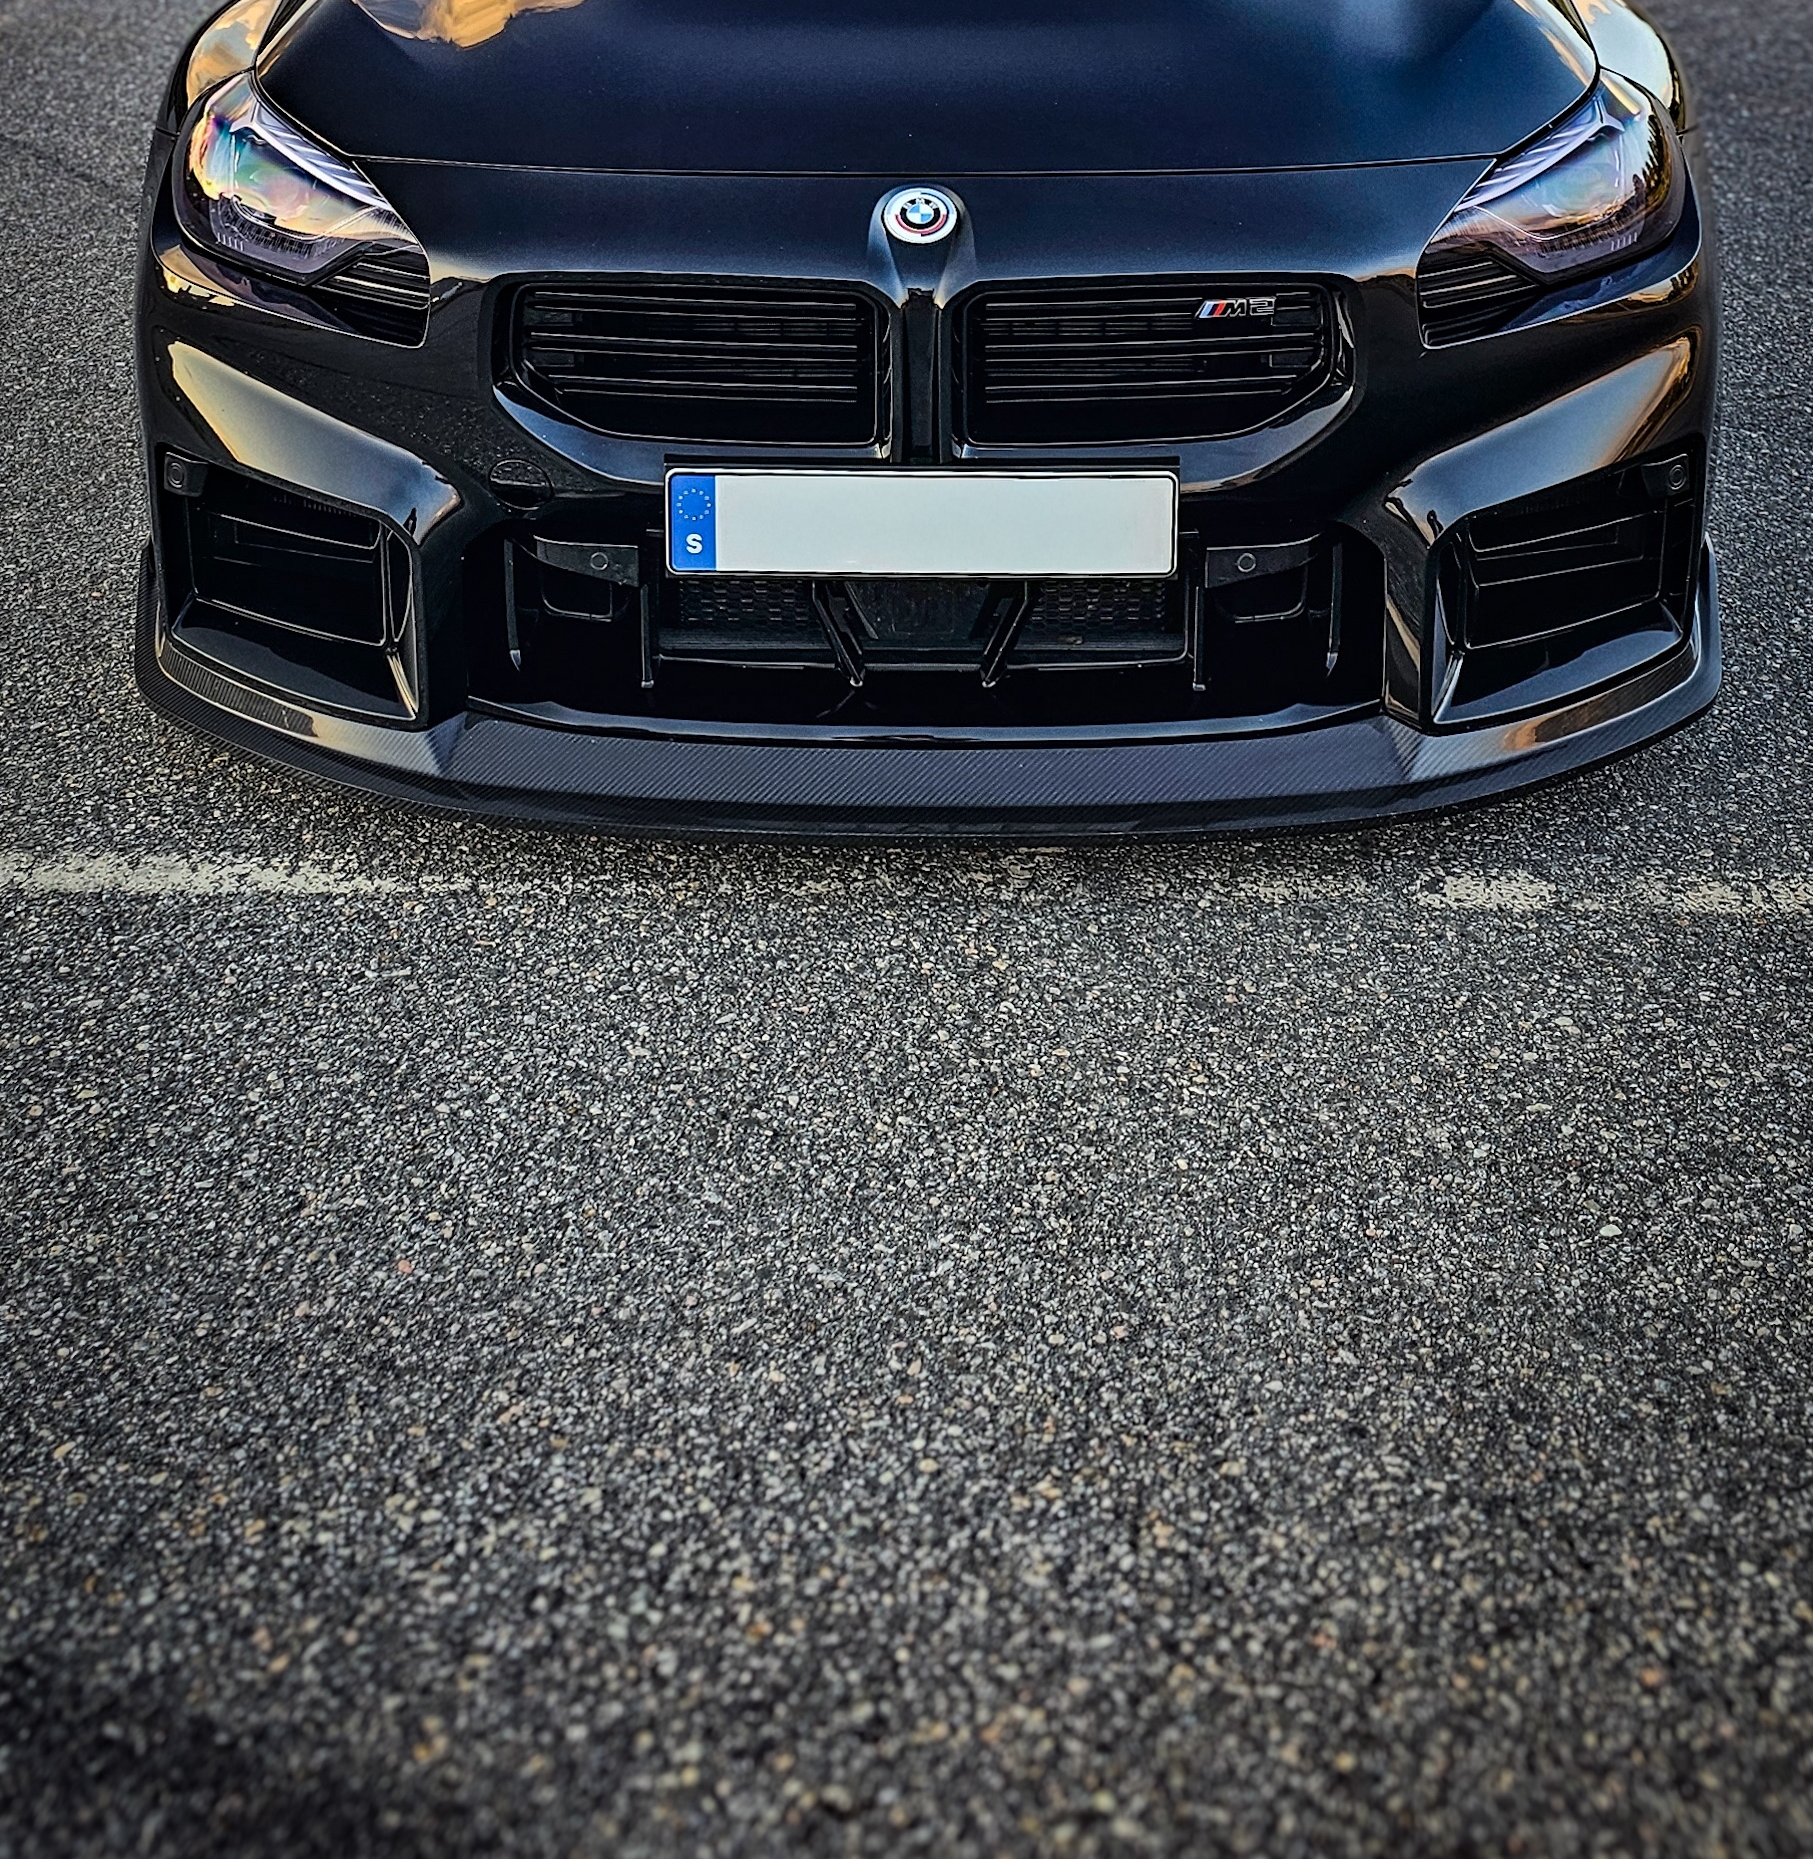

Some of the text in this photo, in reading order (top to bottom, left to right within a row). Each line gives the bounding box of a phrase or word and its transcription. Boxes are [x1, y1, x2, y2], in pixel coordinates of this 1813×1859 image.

[903, 197, 939, 210] BMW
[1217, 298, 1276, 317] M2
[685, 533, 703, 554] S
